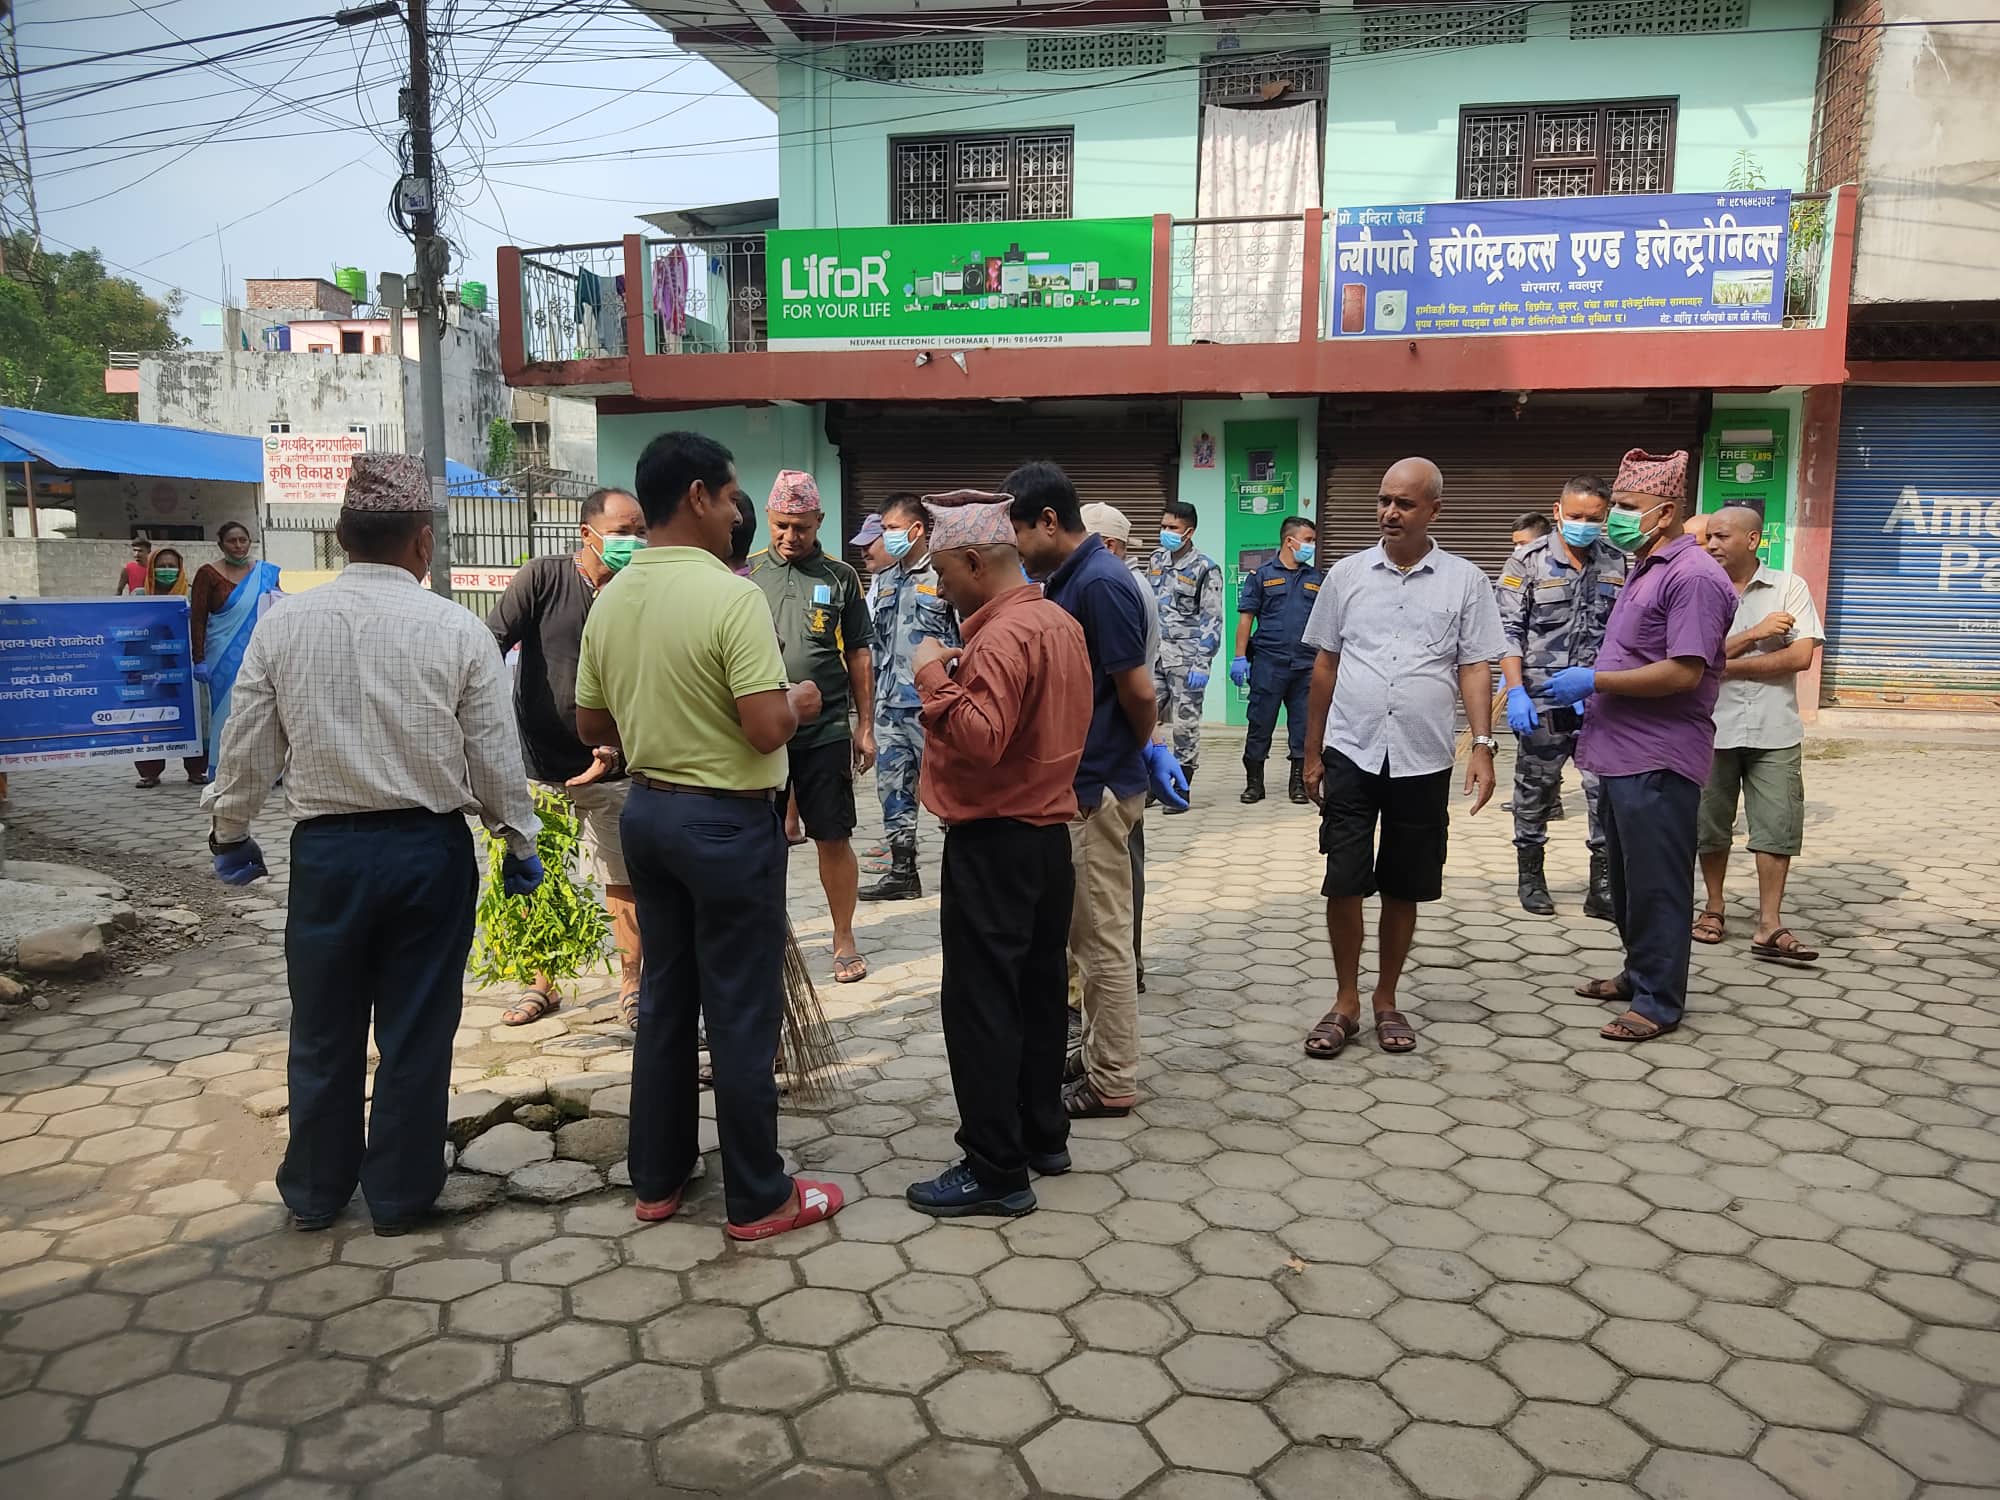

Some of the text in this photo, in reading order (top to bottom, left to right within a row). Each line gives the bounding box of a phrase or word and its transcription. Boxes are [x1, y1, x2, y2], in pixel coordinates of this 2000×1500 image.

[1359, 208, 1392, 226] इन्दिरा
[1338, 213, 1784, 285] न्यौपाने इलेक्ट्रिकल्स एण्ड इलेक्ट्रोनिक्स
[1568, 280, 1604, 294] नवलपुर
[783, 302, 891, 319] FOR YOUR LIFE
[850, 338, 886, 346] NEUPANE
[889, 338, 935, 346] ELECTRONIC
[944, 337, 989, 345] CHORMARA
[1014, 335, 1063, 344] 9816492738
[315, 435, 362, 452] नगरपालिका
[1720, 450, 1748, 460] FREE
[269, 463, 353, 483] कृषि विकास शा
[1241, 485, 1264, 494] FREE
